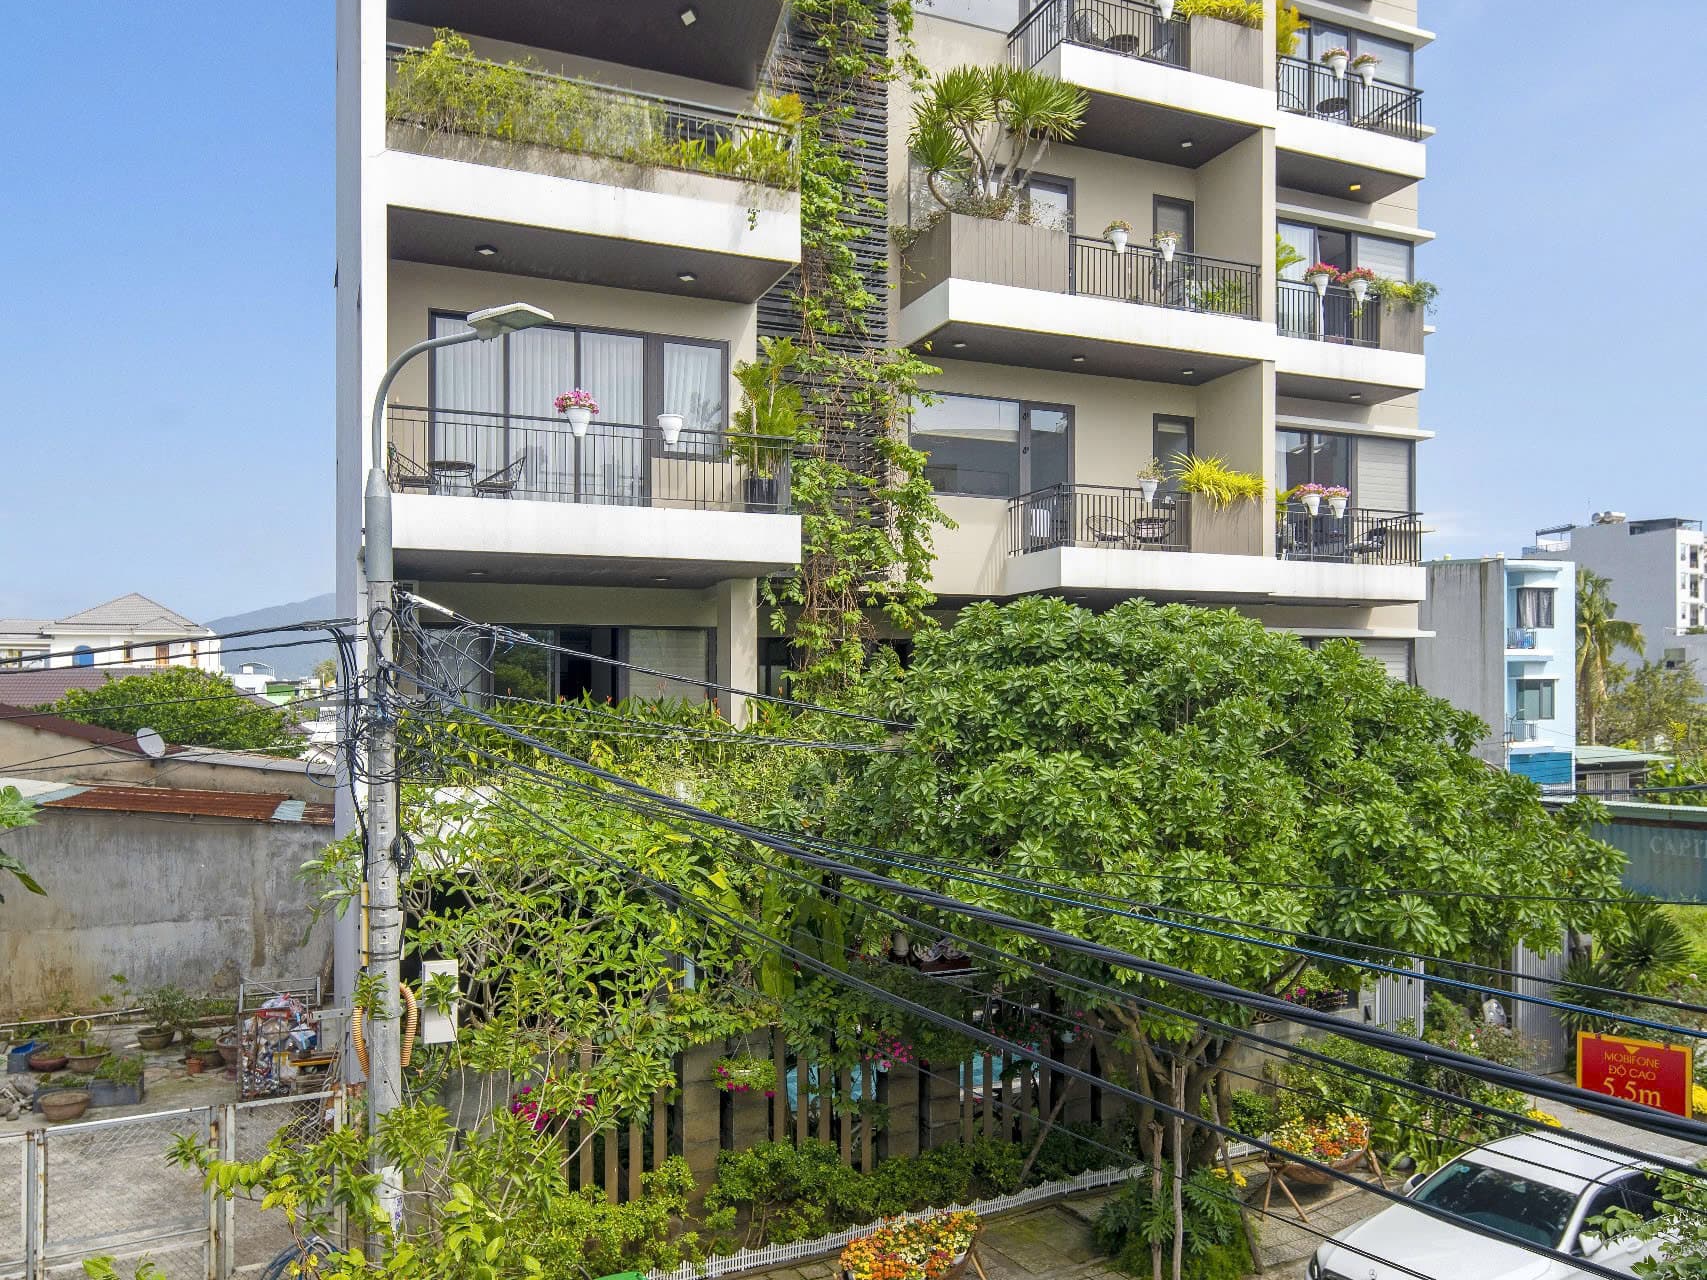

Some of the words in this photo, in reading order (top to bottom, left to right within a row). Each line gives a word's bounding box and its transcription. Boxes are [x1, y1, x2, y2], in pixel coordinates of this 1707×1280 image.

[1604, 1051, 1660, 1069] MOBIFONE
[1608, 1064, 1627, 1078] ĐỘ
[1629, 1068, 1656, 1081] CAO
[1603, 1077, 1662, 1107] 5.5m
